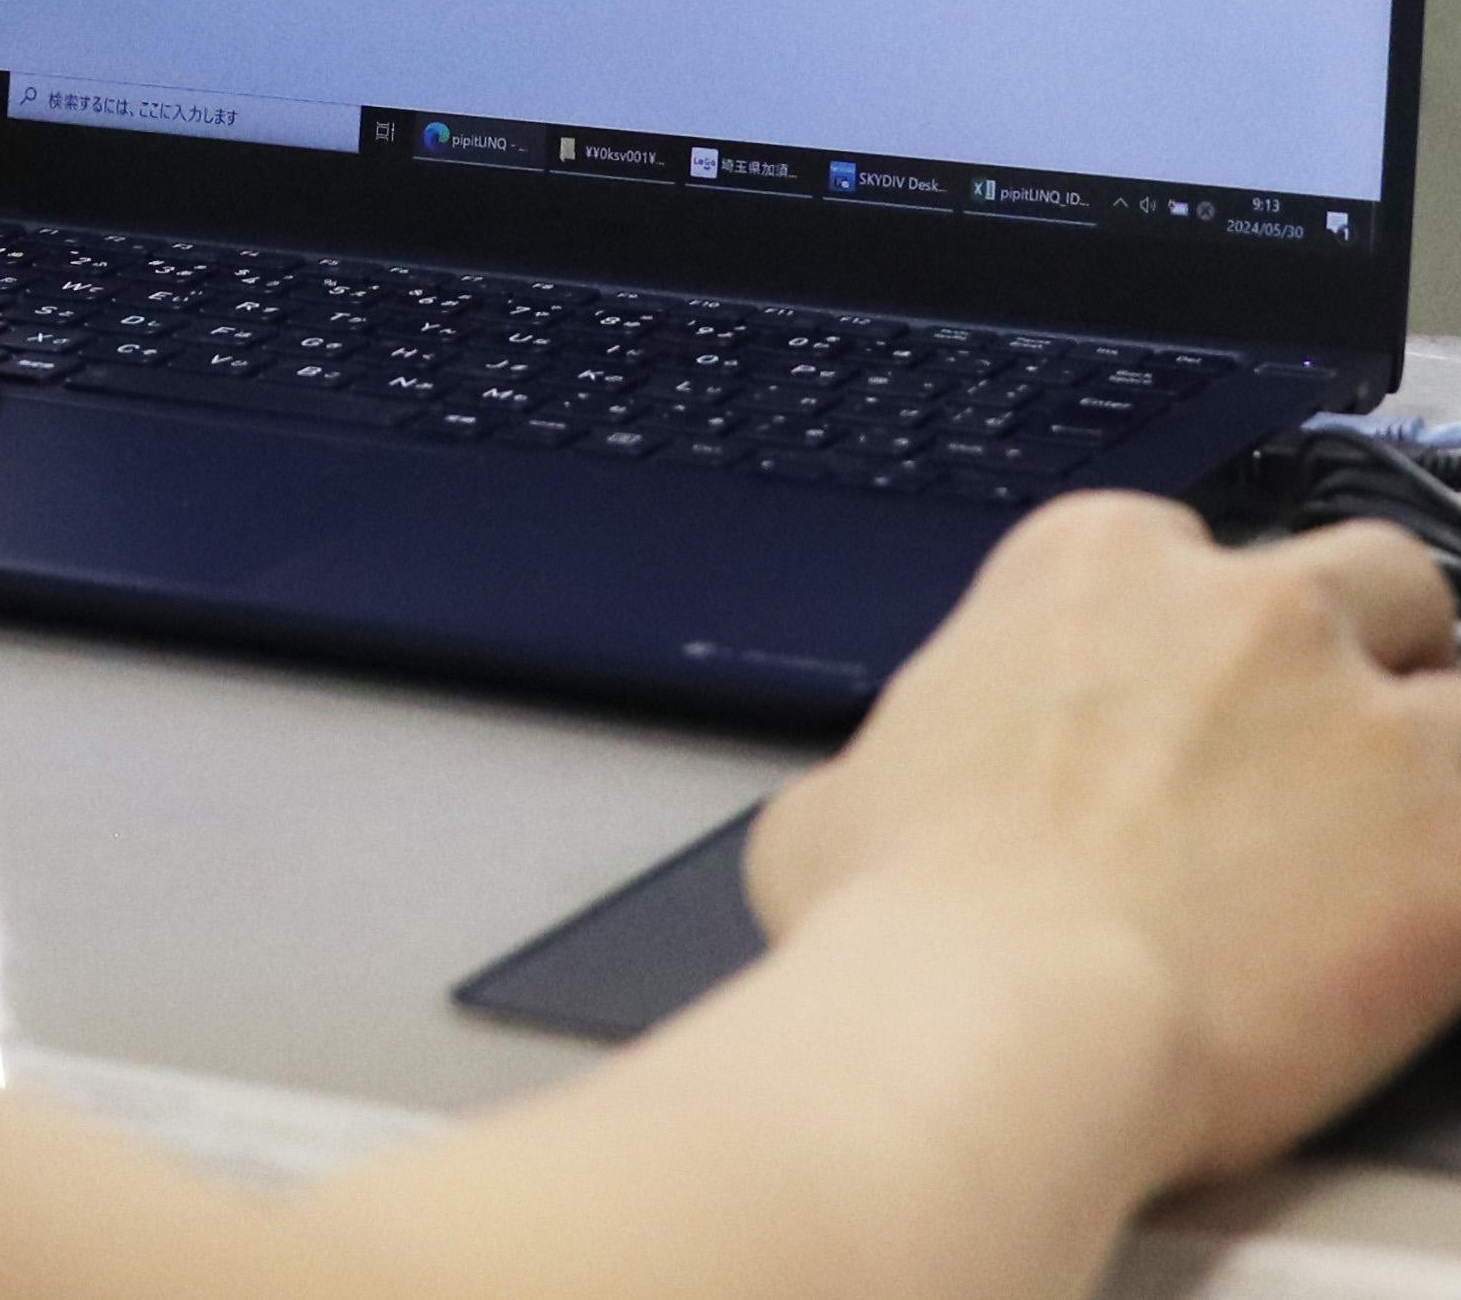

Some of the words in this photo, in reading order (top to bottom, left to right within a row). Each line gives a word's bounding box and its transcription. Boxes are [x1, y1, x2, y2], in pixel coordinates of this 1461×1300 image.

[48, 91, 239, 126] 検索するには、ここに入力します
[859, 172, 905, 189] SKYDIV
[1252, 197, 1280, 213] 9:13
[1226, 219, 1304, 239] 2024/05/30
[34, 305, 58, 315] S
[121, 314, 145, 325] D
[148, 290, 173, 301] E
[508, 332, 534, 343] U
[117, 343, 141, 354] C
